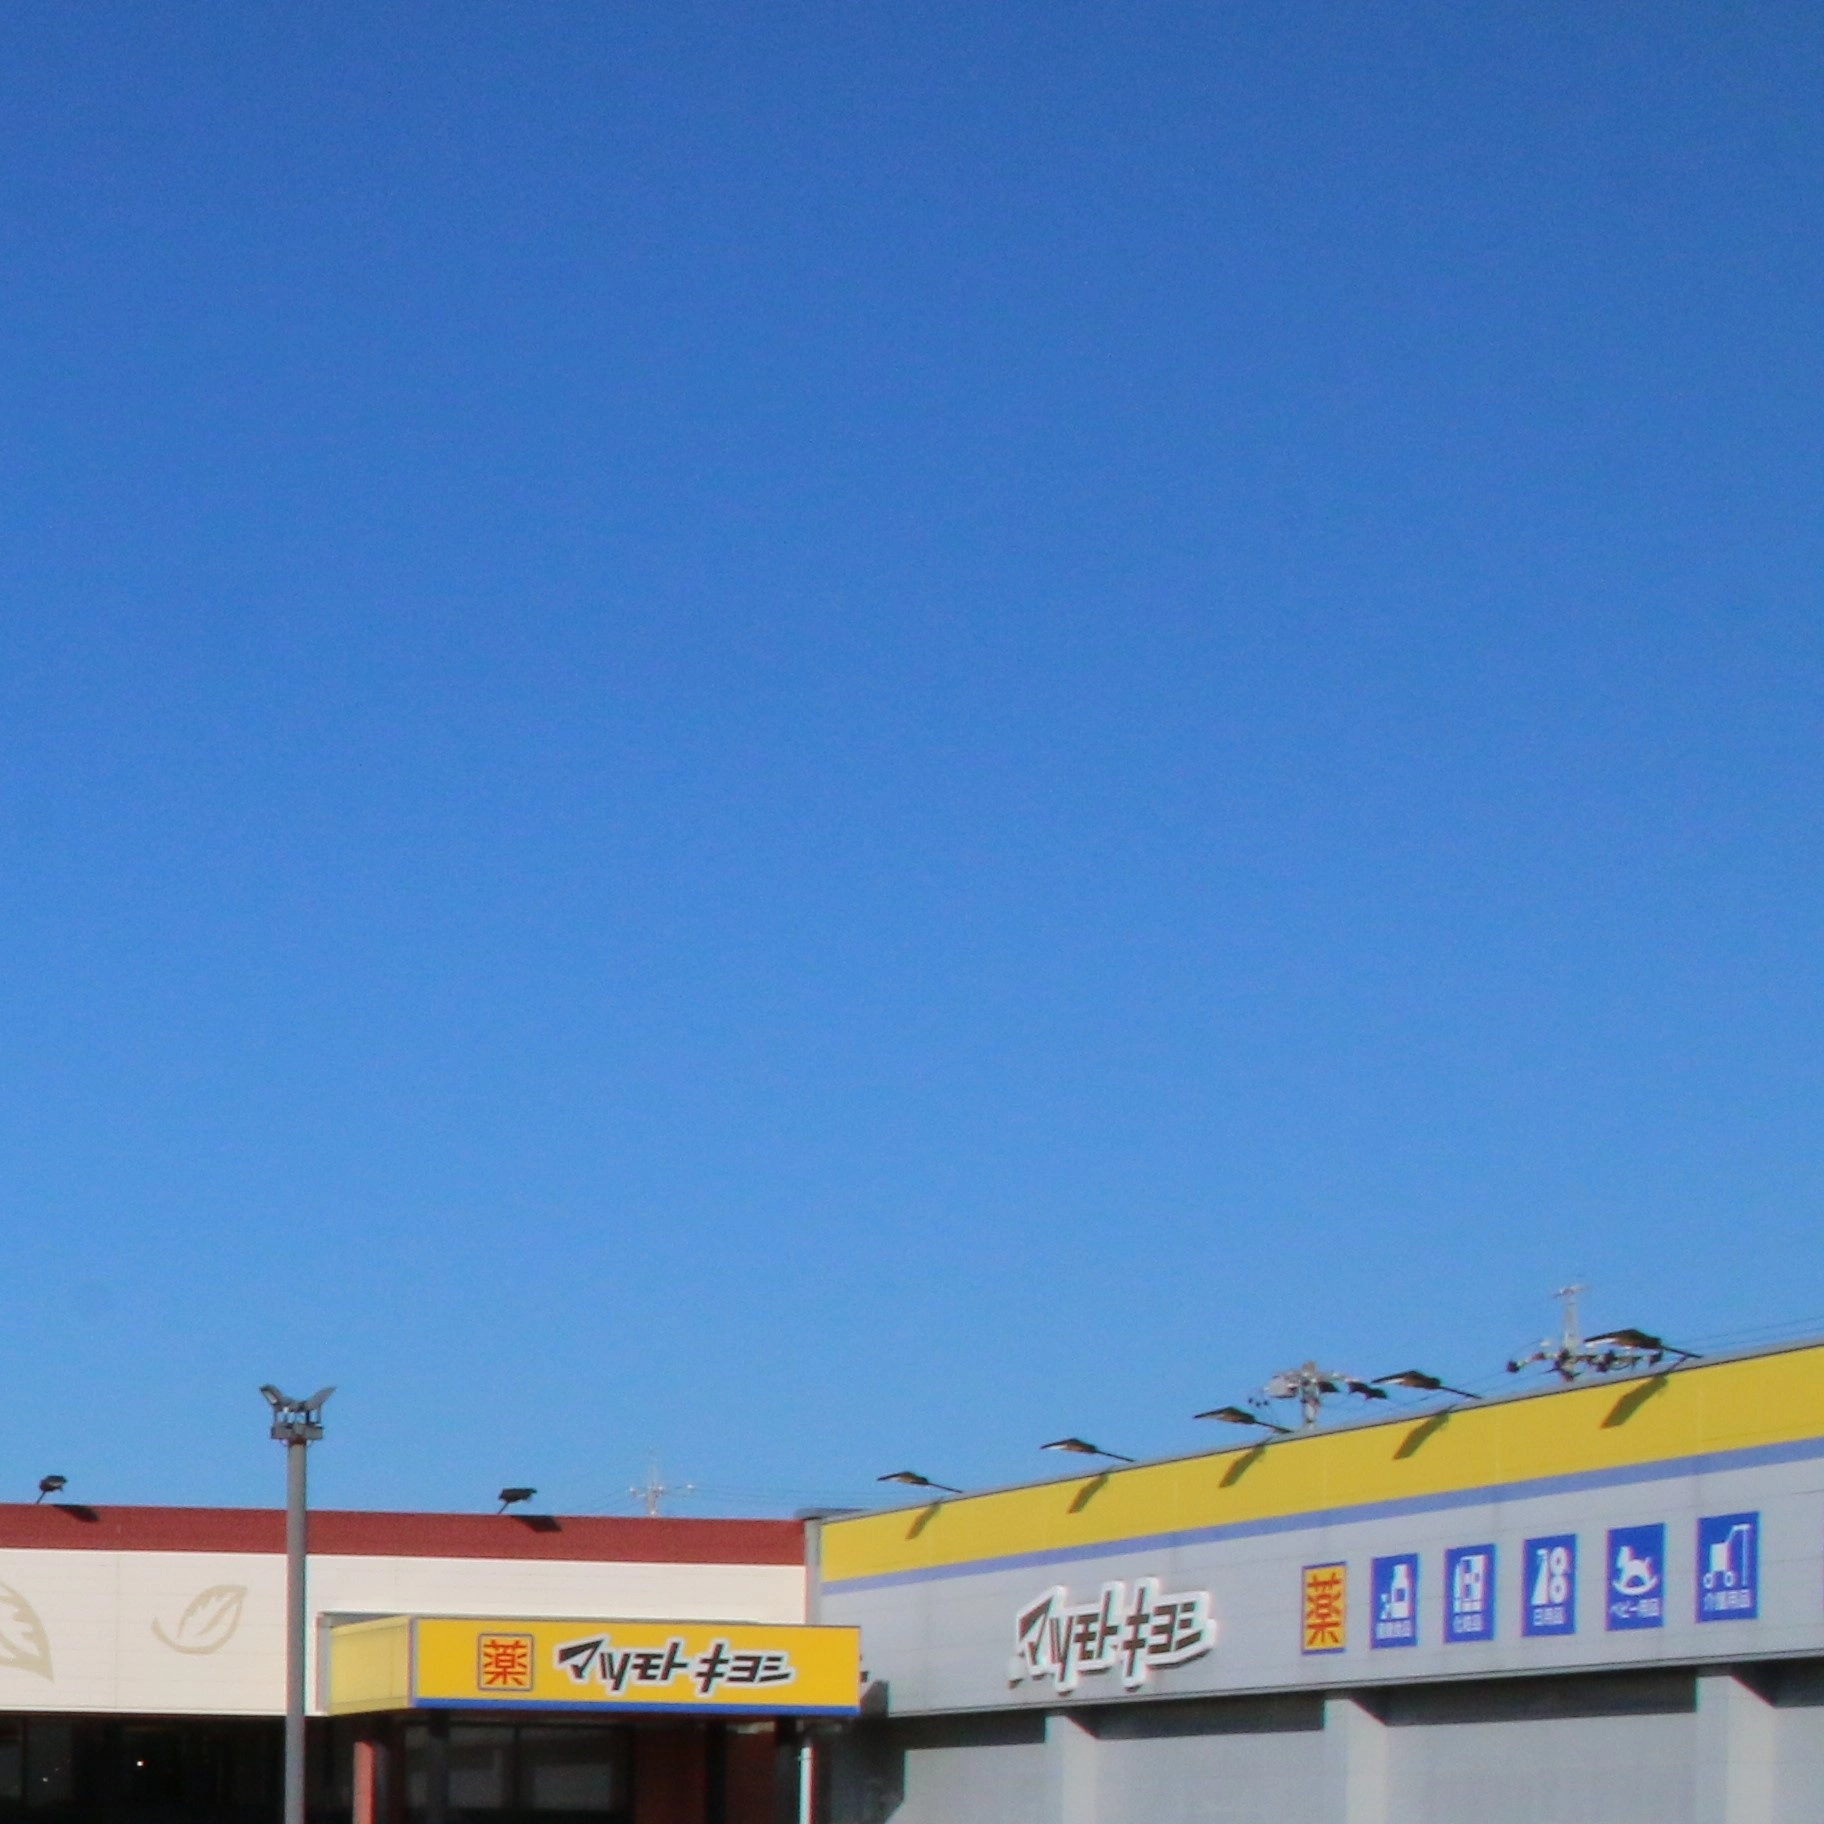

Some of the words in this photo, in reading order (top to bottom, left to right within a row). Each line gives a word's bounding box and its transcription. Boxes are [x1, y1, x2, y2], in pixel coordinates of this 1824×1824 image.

[1305, 1572, 1342, 1645] 薬
[482, 1639, 529, 1687] 薬
[557, 1637, 792, 1694] マツモトキヨシ
